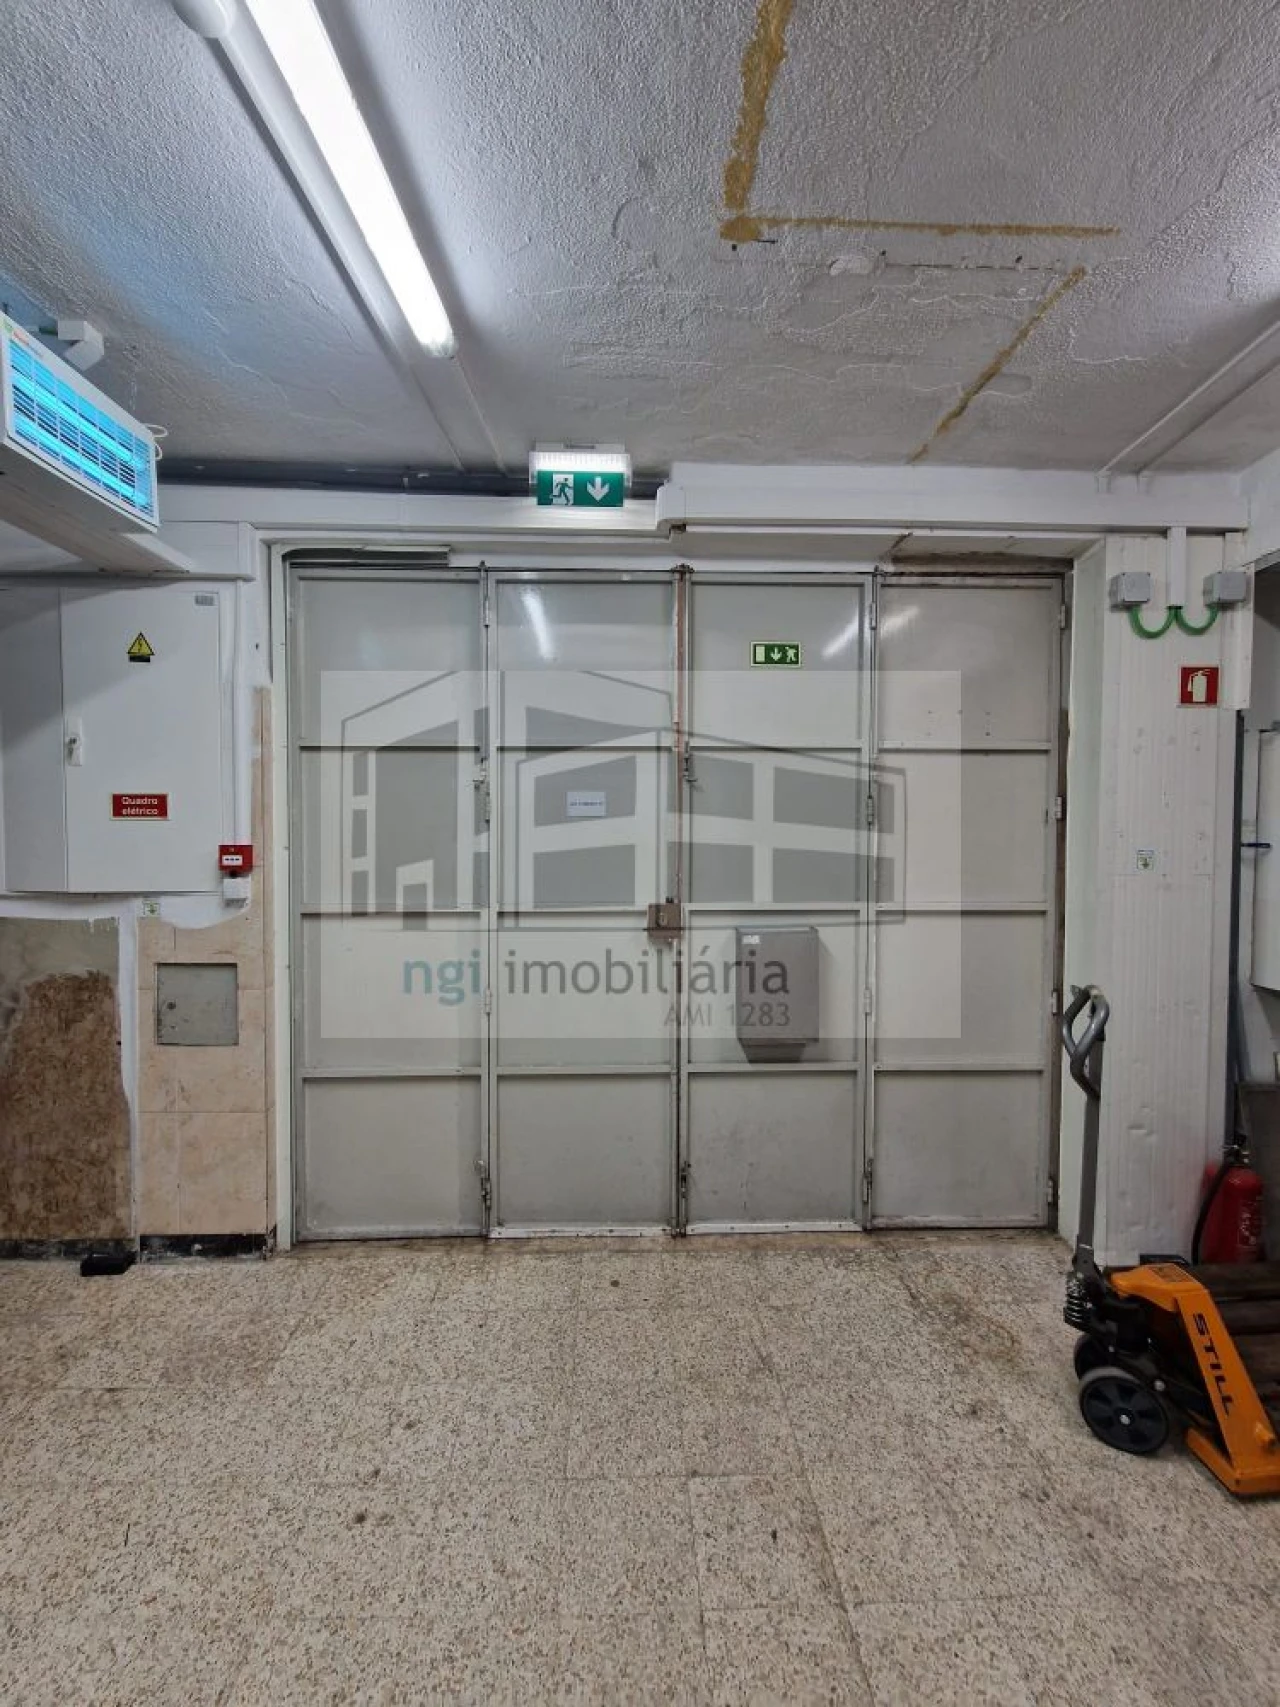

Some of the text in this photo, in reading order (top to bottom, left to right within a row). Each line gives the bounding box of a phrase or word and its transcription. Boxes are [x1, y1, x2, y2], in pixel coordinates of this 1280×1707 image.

[122, 796, 158, 805] Quadro
[122, 806, 158, 815] elétrico
[1193, 1312, 1234, 1416] STILL
